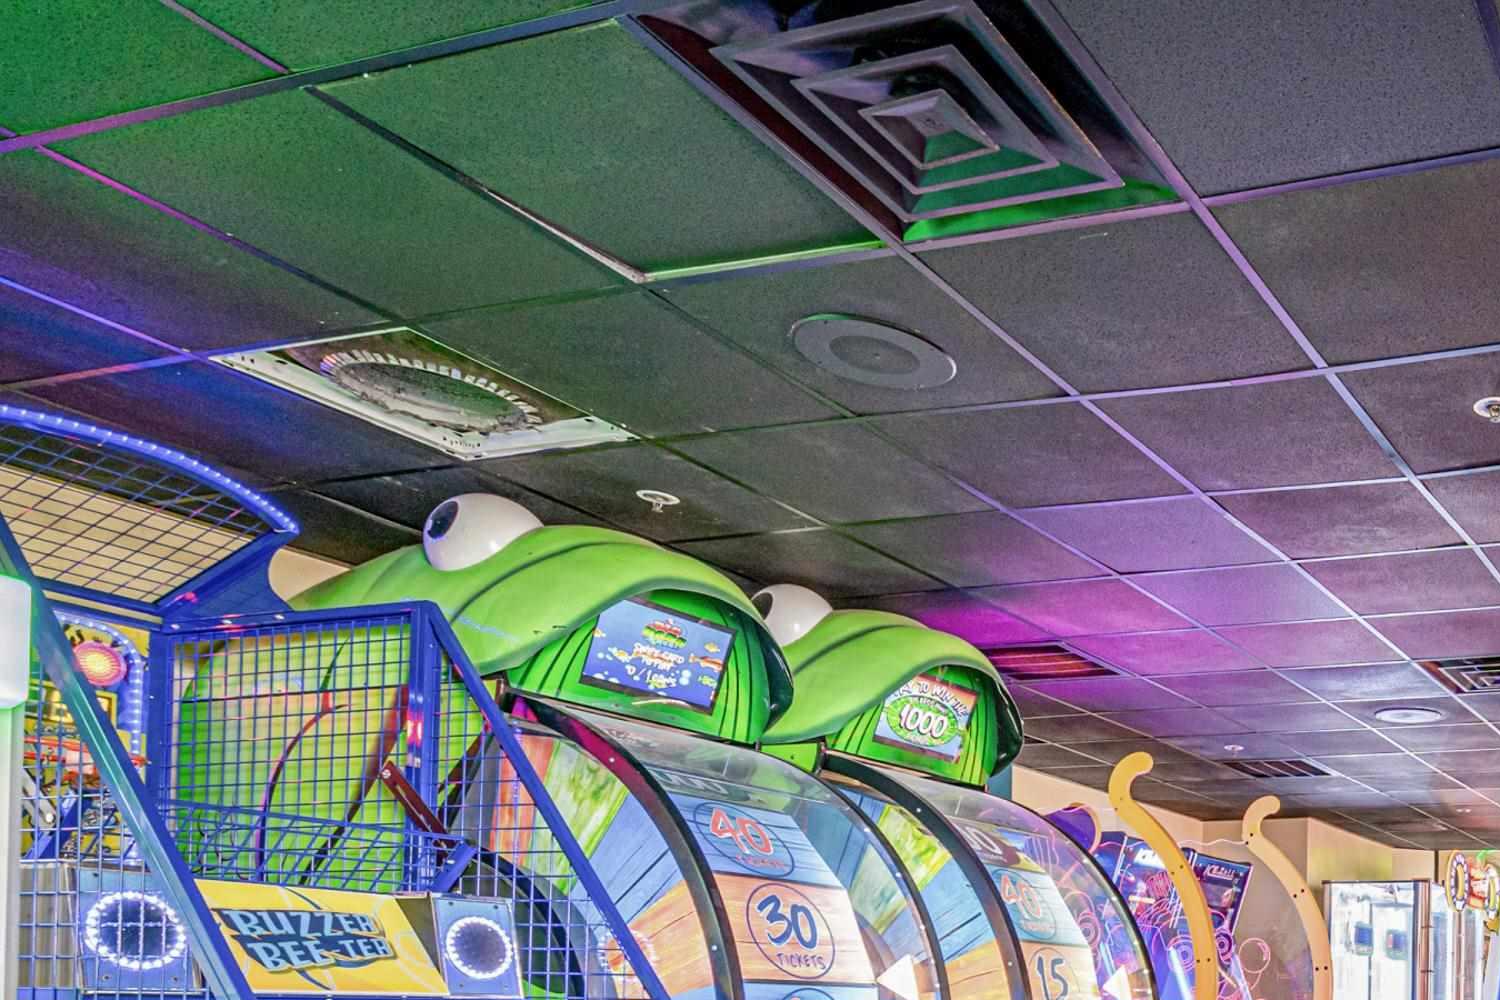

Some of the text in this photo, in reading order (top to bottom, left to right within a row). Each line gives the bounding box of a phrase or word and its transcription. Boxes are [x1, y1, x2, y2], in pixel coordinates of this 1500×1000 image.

[898, 703, 949, 739] 1000
[710, 808, 773, 856] 40
[1001, 874, 1041, 921] 40
[222, 909, 377, 937] BUZZER
[757, 893, 818, 950] 30
[247, 936, 393, 971] BEE-TER
[775, 951, 828, 971] TICKETS
